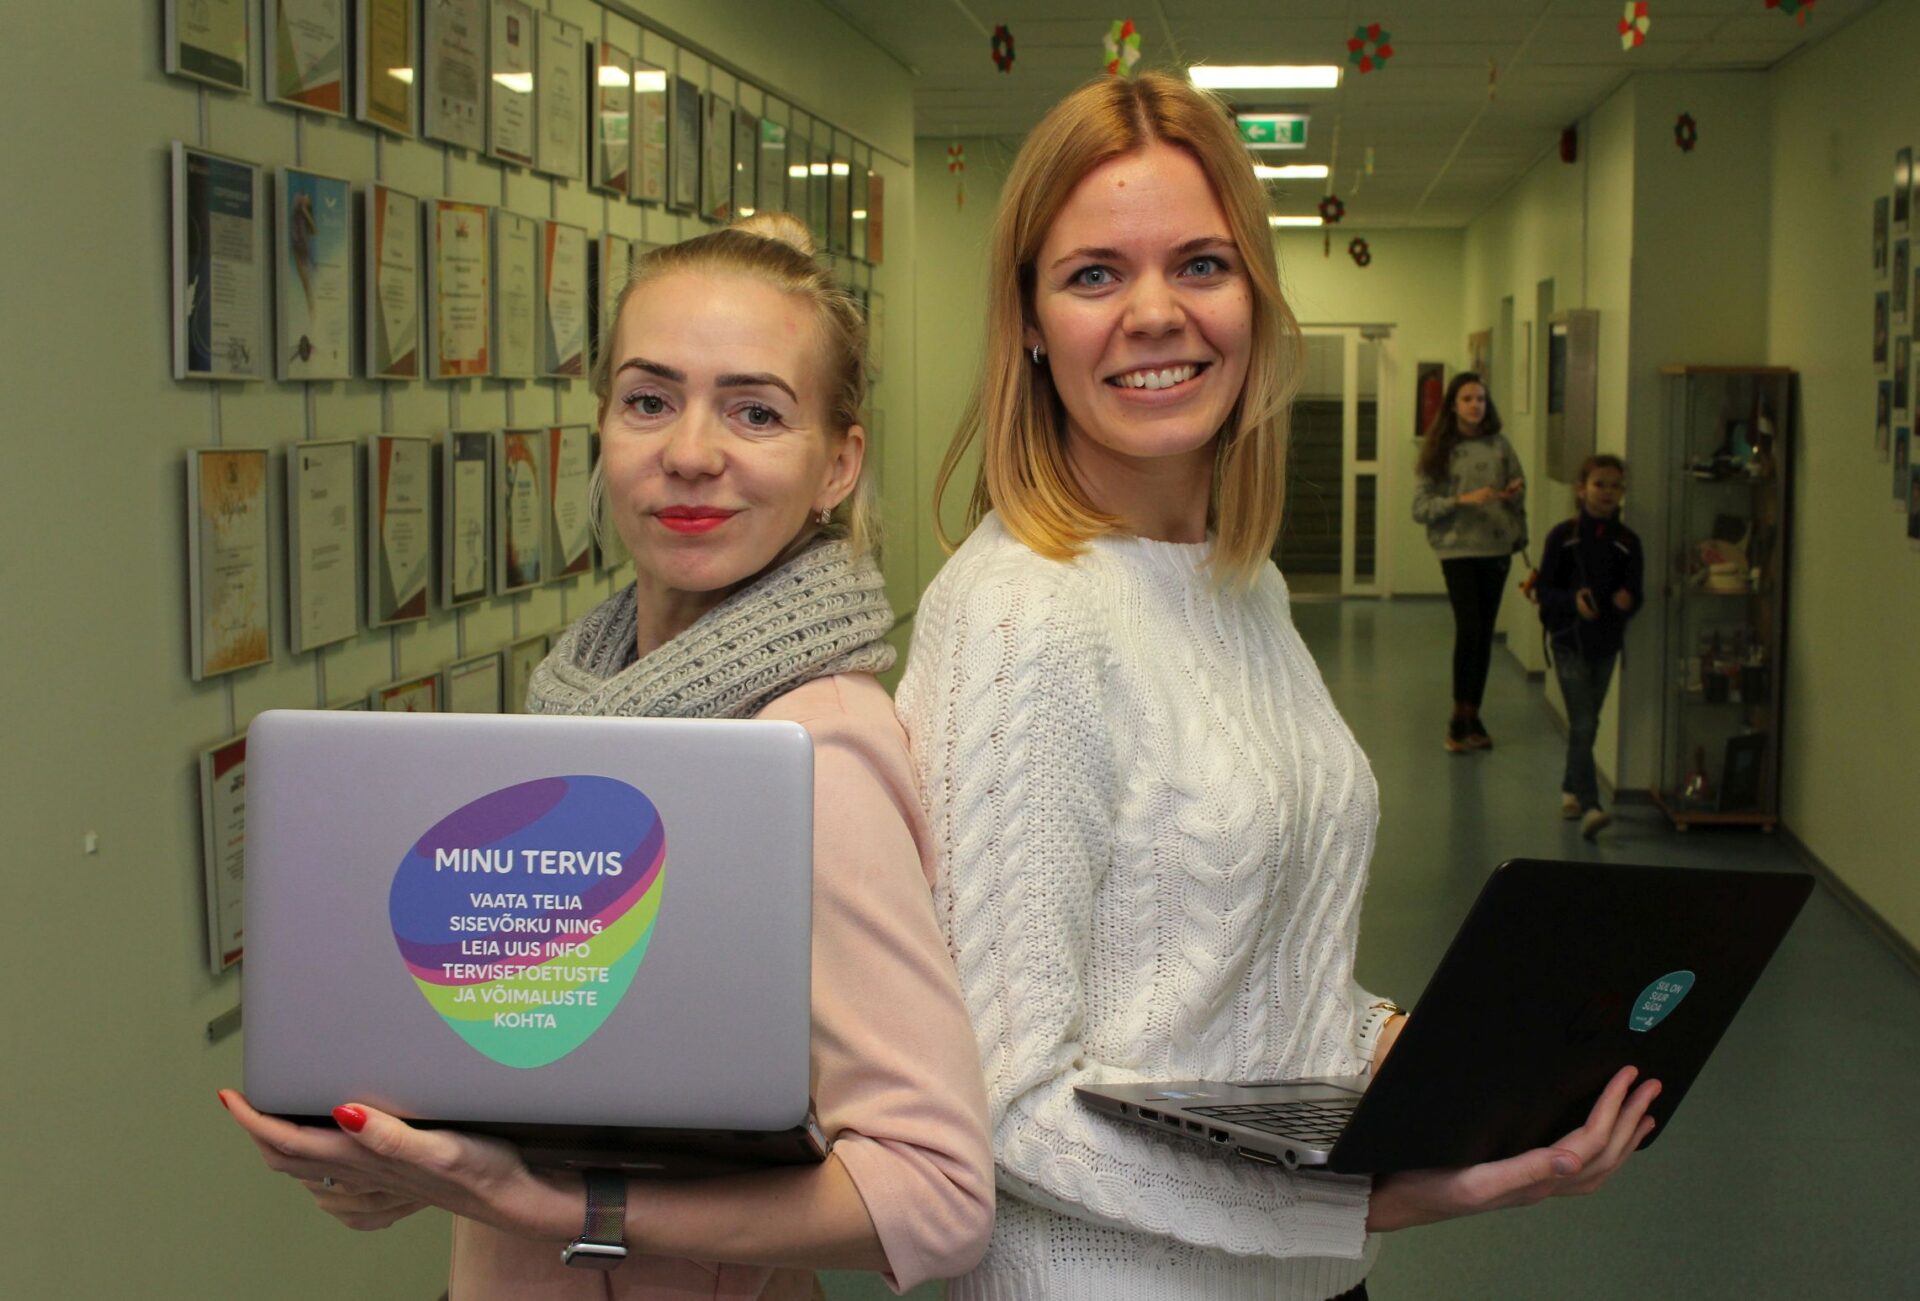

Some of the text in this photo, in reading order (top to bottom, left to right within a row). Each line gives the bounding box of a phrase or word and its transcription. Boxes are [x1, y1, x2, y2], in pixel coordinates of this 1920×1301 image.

[435, 848, 623, 876] MINU TERVIS
[470, 893, 583, 911] VAATA TELIA
[449, 913, 603, 935] SISEVÕRKU NING
[461, 940, 591, 958] LEIA UUS INFO
[442, 963, 610, 983] TERVISETOETUSTE
[453, 984, 598, 1006] JA VÕIMALUSTE
[493, 1012, 557, 1029] KOHTA
